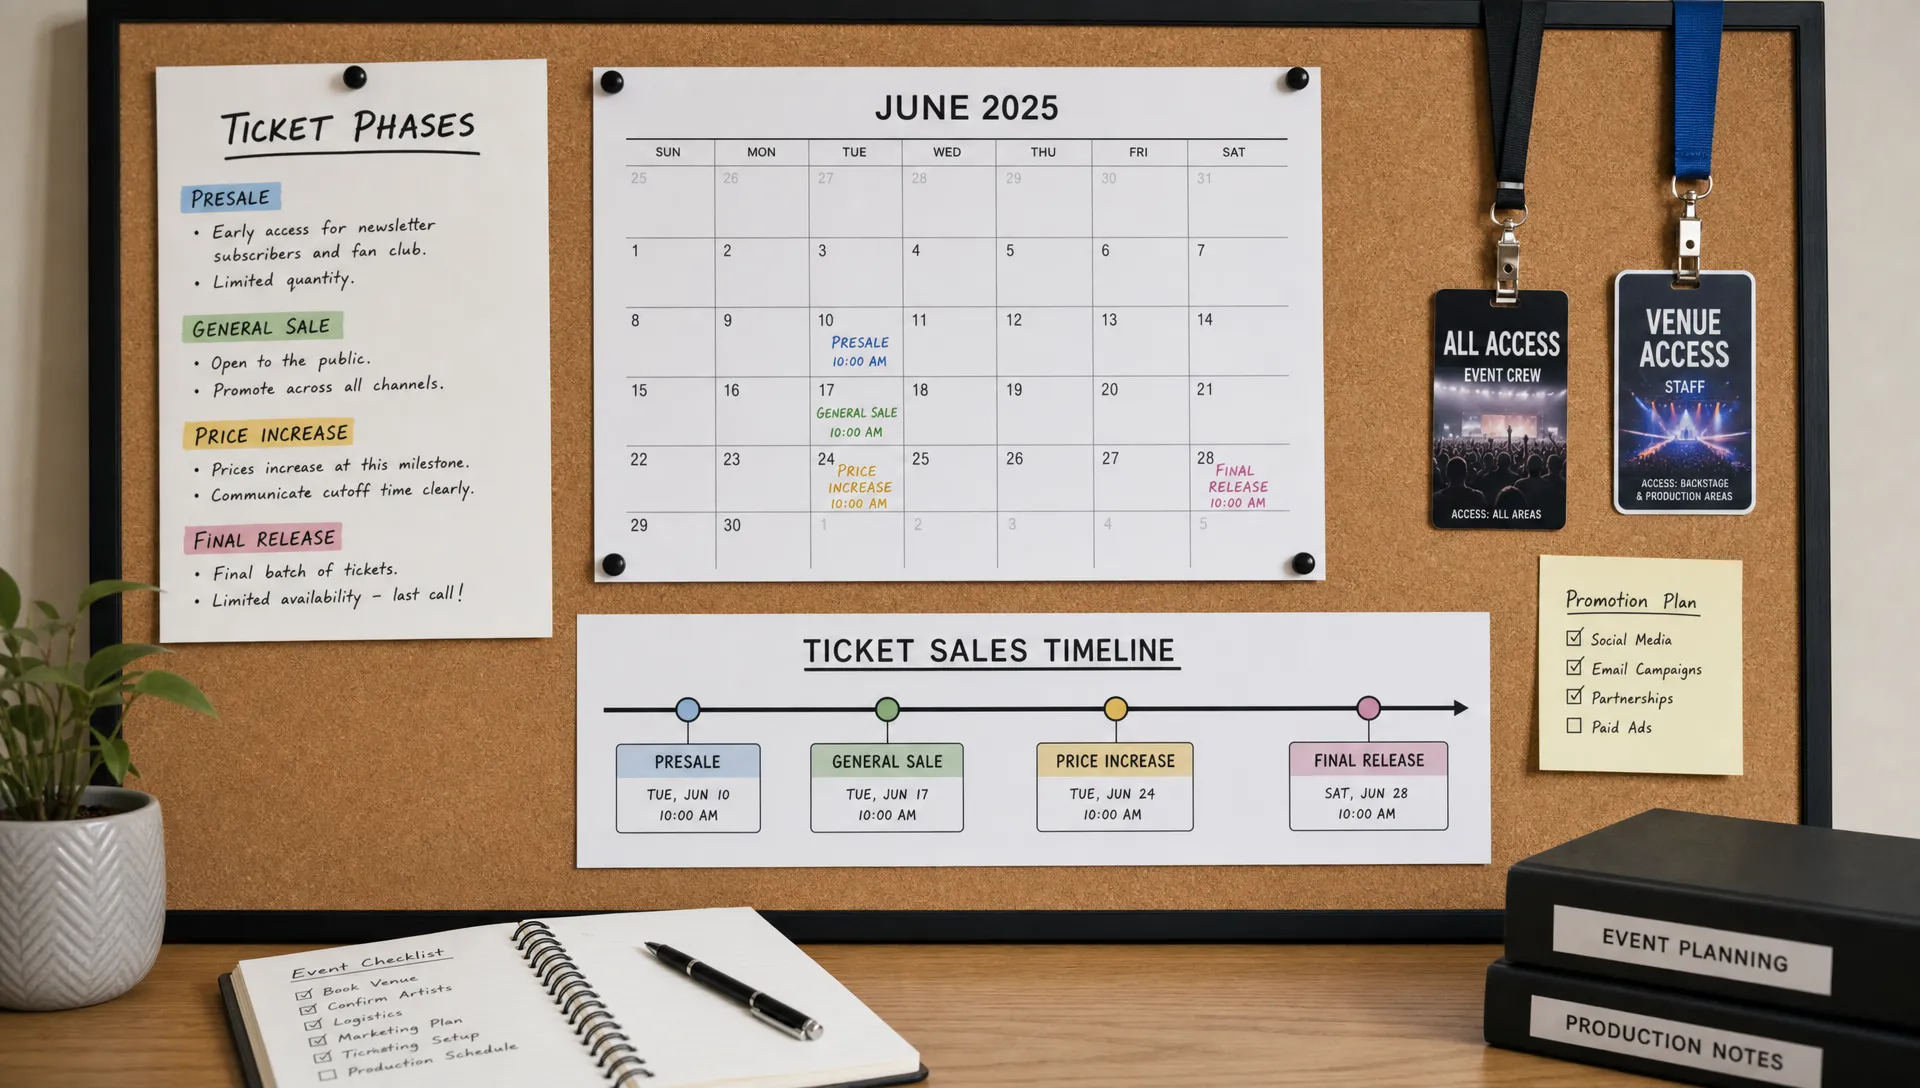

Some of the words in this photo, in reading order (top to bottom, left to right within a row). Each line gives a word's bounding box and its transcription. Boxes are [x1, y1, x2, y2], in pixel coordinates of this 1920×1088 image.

[875, 95, 969, 120] JUNE
[983, 95, 1058, 120] 2025
[221, 112, 334, 145] TICKET
[354, 110, 474, 142] PHASES
[656, 147, 680, 157] SUN
[748, 147, 775, 157] MON
[843, 147, 866, 157] TUE
[933, 147, 961, 157] WED
[1031, 147, 1055, 157] THU
[1130, 147, 1147, 157] FRI
[1223, 147, 1245, 157] SAT
[192, 189, 269, 208] PRESALE
[213, 224, 254, 244] Early
[266, 227, 309, 236] access
[322, 219, 346, 235] for
[359, 218, 435, 232] newsletter
[214, 246, 300, 262] subscribers
[313, 244, 340, 258] and
[352, 243, 376, 258] fan
[389, 242, 425, 256] club.
[214, 272, 273, 288] Limited
[287, 270, 354, 292] quantity.
[819, 314, 833, 326] 10
[913, 314, 925, 326] 11
[1102, 313, 1117, 326] 13
[1646, 309, 1721, 335] VENUE
[193, 321, 272, 338] GENERAL
[286, 318, 329, 334] SALE
[832, 336, 889, 349] PRESALE
[1444, 331, 1479, 355] ALL
[1485, 331, 1560, 356] ACCESS
[1640, 341, 1729, 367] ACCESS
[212, 356, 246, 375] Open
[257, 355, 271, 367] to
[282, 353, 306, 366] the
[318, 351, 370, 372] public.
[833, 357, 864, 366] 10:00
[869, 356, 886, 366] AM
[1464, 368, 1503, 382] EVENT
[1507, 368, 1541, 382] CREW
[214, 382, 275, 398] Promote
[287, 384, 332, 394] across
[345, 377, 362, 392] all
[374, 375, 443, 391] channels.
[632, 384, 647, 396] 15
[820, 384, 834, 396] 17
[913, 383, 928, 396] 18
[1102, 383, 1118, 395] 20
[1665, 380, 1705, 393] STAFF
[817, 407, 866, 419] GENERAL
[871, 407, 897, 418] SALE
[196, 427, 248, 446] PRICE
[262, 425, 347, 442] INCREASE
[830, 428, 860, 437] 10:00
[865, 427, 882, 437] AM
[631, 453, 647, 466] 22
[819, 452, 834, 465] 24
[1007, 452, 1023, 465] 26
[1198, 451, 1214, 464] 28
[212, 462, 254, 476] Prices
[266, 462, 323, 473] increase
[335, 459, 350, 471] at
[361, 457, 387, 471] this
[399, 456, 469, 469] milestone.
[838, 464, 876, 477] PRICE
[1216, 463, 1254, 476] FINAL
[829, 482, 892, 493] INCREASE
[1209, 481, 1268, 492] RELEASE
[1642, 479, 1677, 488] ACCESS:
[1681, 479, 1728, 487] BACKSTAGE
[212, 486, 311, 502] Communicate
[323, 482, 371, 498] cutoff
[381, 483, 412, 496] time
[423, 480, 473, 501] clearly.
[1637, 492, 1642, 500] &
[1646, 492, 1701, 500] PRODUCTION
[1705, 492, 1732, 500] AREAS
[832, 499, 863, 508] 10:00
[869, 498, 887, 509] AM
[1211, 498, 1242, 508] 10:00
[1248, 497, 1265, 508] AM
[1452, 509, 1489, 518] ACCESS:
[1493, 510, 1509, 519] ALL
[1512, 510, 1541, 519] AREAS
[631, 518, 647, 531] 29
[257, 530, 335, 547] RELEASE
[214, 565, 253, 581] Final
[266, 564, 305, 578] batch
[318, 562, 334, 577] of
[344, 562, 397, 576] tickets.
[213, 591, 270, 607] Limited
[281, 589, 361, 610] availability
[394, 587, 419, 601] last
[1567, 590, 1647, 608] Promotion
[1664, 593, 1696, 609] Plan
[1591, 633, 1627, 646] Social
[1636, 632, 1672, 645] Media
[803, 639, 914, 662] TICKET
[931, 638, 1027, 662] SALES
[1044, 639, 1174, 662] TIMELINE
[1592, 662, 1627, 675] Email
[1636, 663, 1701, 680] Campaigns
[1592, 691, 1673, 710] Partnerships
[1593, 720, 1619, 733] Paid
[1628, 720, 1651, 733] Ads
[656, 755, 720, 768] PRESALE
[833, 755, 899, 768] GENERAL
[907, 755, 942, 768] SALE
[1057, 754, 1098, 768] PRICE
[1106, 754, 1175, 767] INCREASE
[1315, 754, 1356, 767] FINAL
[1363, 753, 1424, 767] RELEASE
[647, 789, 676, 802] TUE,
[684, 789, 708, 800] JUN
[718, 790, 729, 800] 10
[846, 789, 875, 802] TUE,
[883, 789, 907, 800] JUN
[917, 789, 928, 799] 17
[1070, 788, 1099, 801] TUE,
[1107, 788, 1131, 799] JUN
[1139, 788, 1155, 799] 24
[1325, 787, 1353, 800] SAT,
[1361, 788, 1384, 799] JUN
[1393, 788, 1407, 798] 28
[660, 810, 693, 821] 10:00
[699, 810, 717, 821] AM
[859, 810, 892, 820] 10:00
[898, 809, 916, 820] AM
[1084, 809, 1117, 820] 10:00
[1123, 809, 1141, 820] AM
[1339, 809, 1372, 819] 10:00
[1377, 808, 1395, 819] AM
[1602, 928, 1669, 953] EVENT
[1679, 941, 1788, 972] PLANNING
[292, 962, 349, 979] Event
[362, 948, 445, 968] Checklist
[323, 984, 360, 996] Book
[370, 976, 418, 987] Venue
[328, 997, 387, 1010] Confirm
[400, 985, 452, 999] Artists
[334, 1011, 402, 1027] Logistics
[338, 1024, 419, 1042] Marketing
[431, 1018, 462, 1028] Plan
[433, 1033, 479, 1044] Setup
[1566, 1015, 1701, 1055] PRODUCTION
[1713, 1042, 1783, 1070] NOTES
[348, 1057, 434, 1077] Production
[446, 1043, 519, 1060] Schedule
